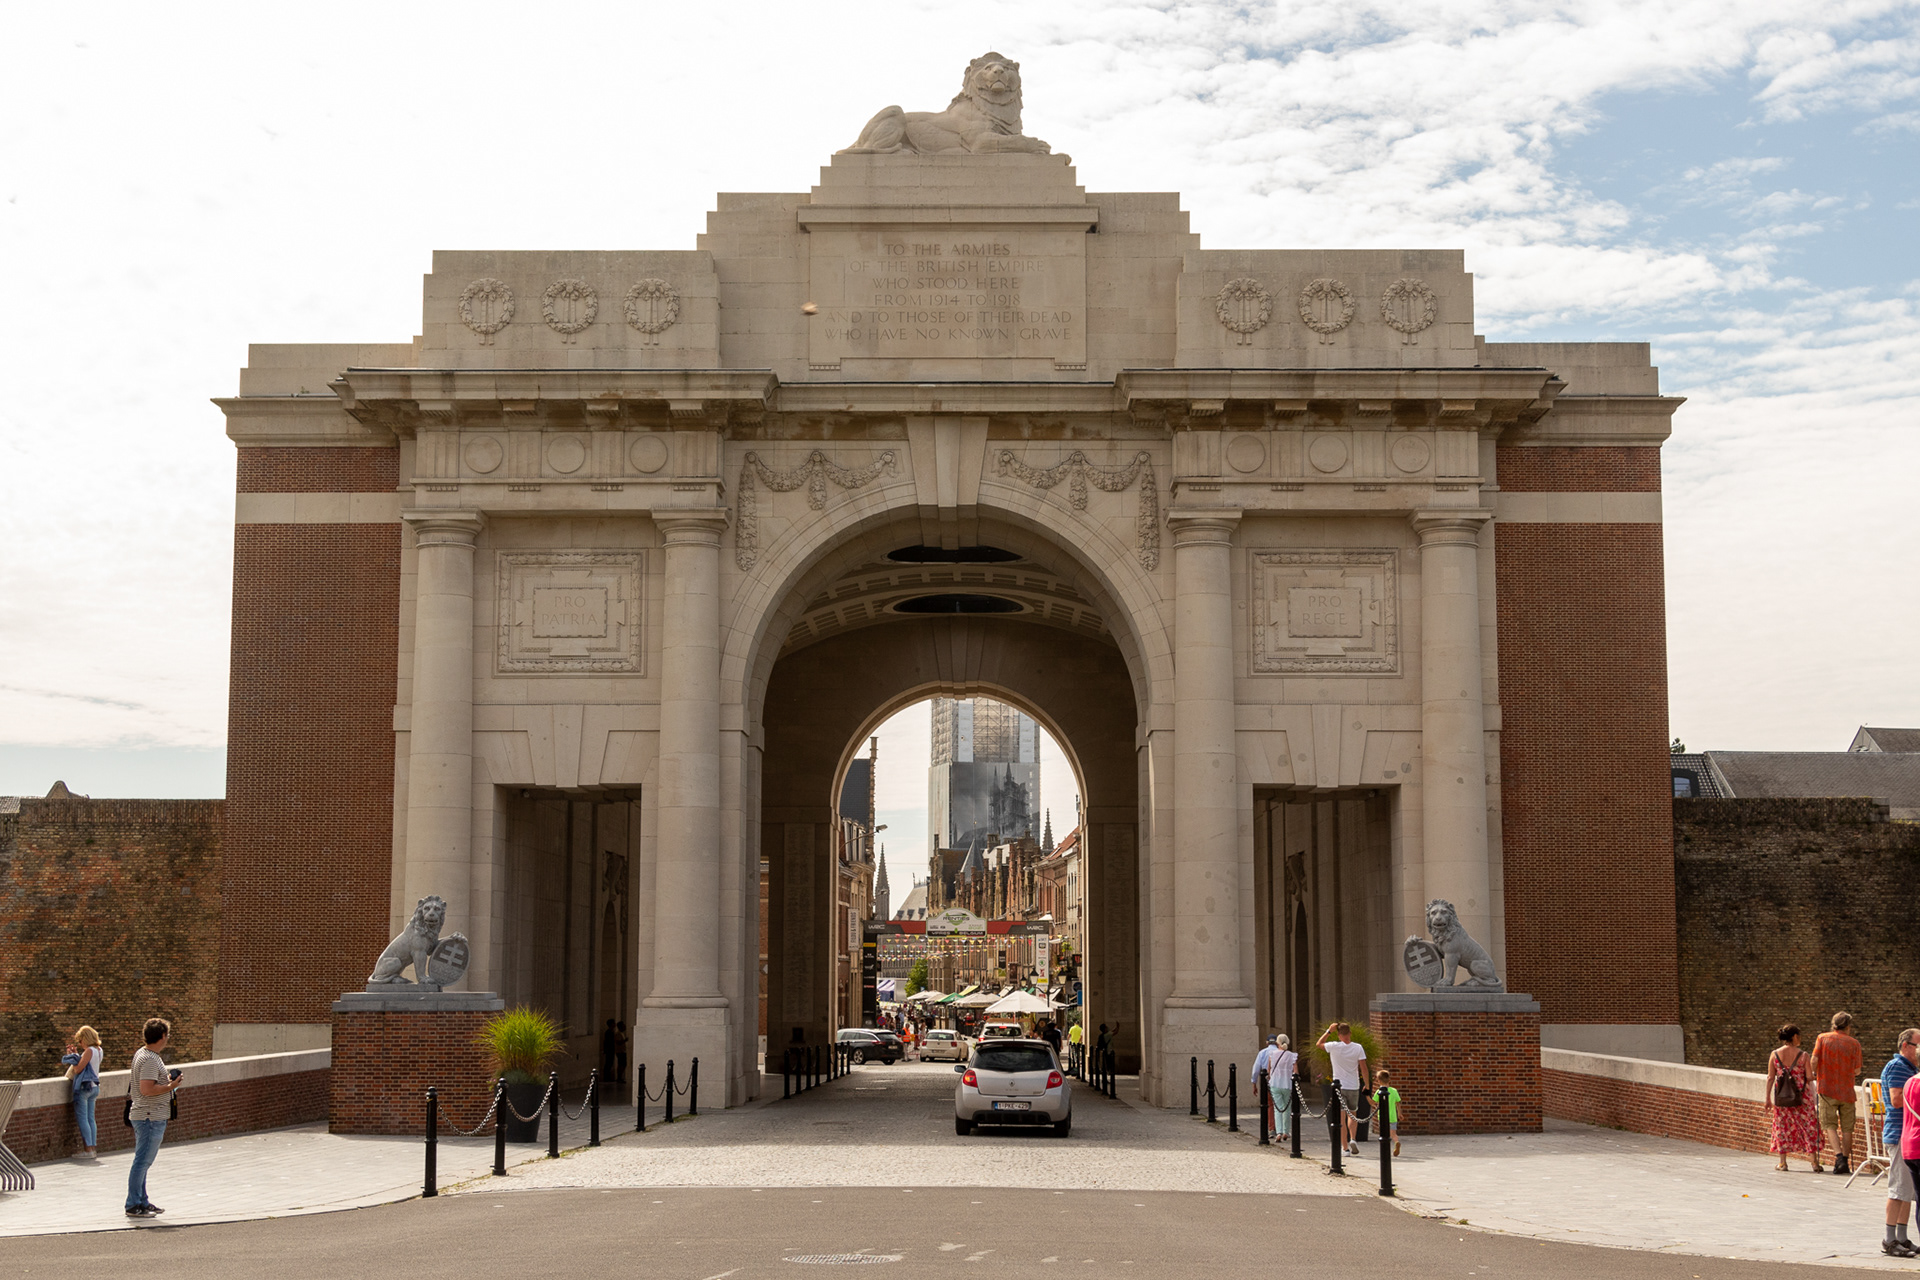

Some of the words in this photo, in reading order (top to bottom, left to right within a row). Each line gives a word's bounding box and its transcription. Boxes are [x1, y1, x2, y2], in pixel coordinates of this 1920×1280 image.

[885, 244, 905, 256] TO
[912, 244, 942, 256] THE
[951, 244, 1011, 256] ARMIES
[850, 261, 870, 273] OF
[877, 261, 907, 273] THE
[917, 261, 979, 273] BRITISH
[989, 261, 1044, 273] EMPIRE
[873, 278, 910, 289] WHO
[917, 278, 968, 289] STOOD
[976, 278, 1019, 289] HERE
[875, 294, 922, 306] FROM
[930, 294, 960, 306] 1914
[967, 294, 987, 306] TO
[993, 294, 1021, 306] 1918
[825, 311, 862, 323] AND
[869, 311, 890, 323] TO
[896, 311, 946, 323] THOSE
[955, 311, 974, 323] OF
[980, 311, 1026, 323] THEIR
[1031, 311, 1072, 323] DEAD
[825, 328, 862, 340] WHO
[869, 328, 907, 340] HAVE
[916, 328, 940, 340] NO
[949, 328, 1009, 340] KNOWN
[1020, 328, 1071, 340] GRAVE
[554, 595, 586, 608] PRO
[1308, 595, 1342, 608] PRO
[541, 613, 598, 625] PATRIA
[1302, 613, 1348, 625] REGE
